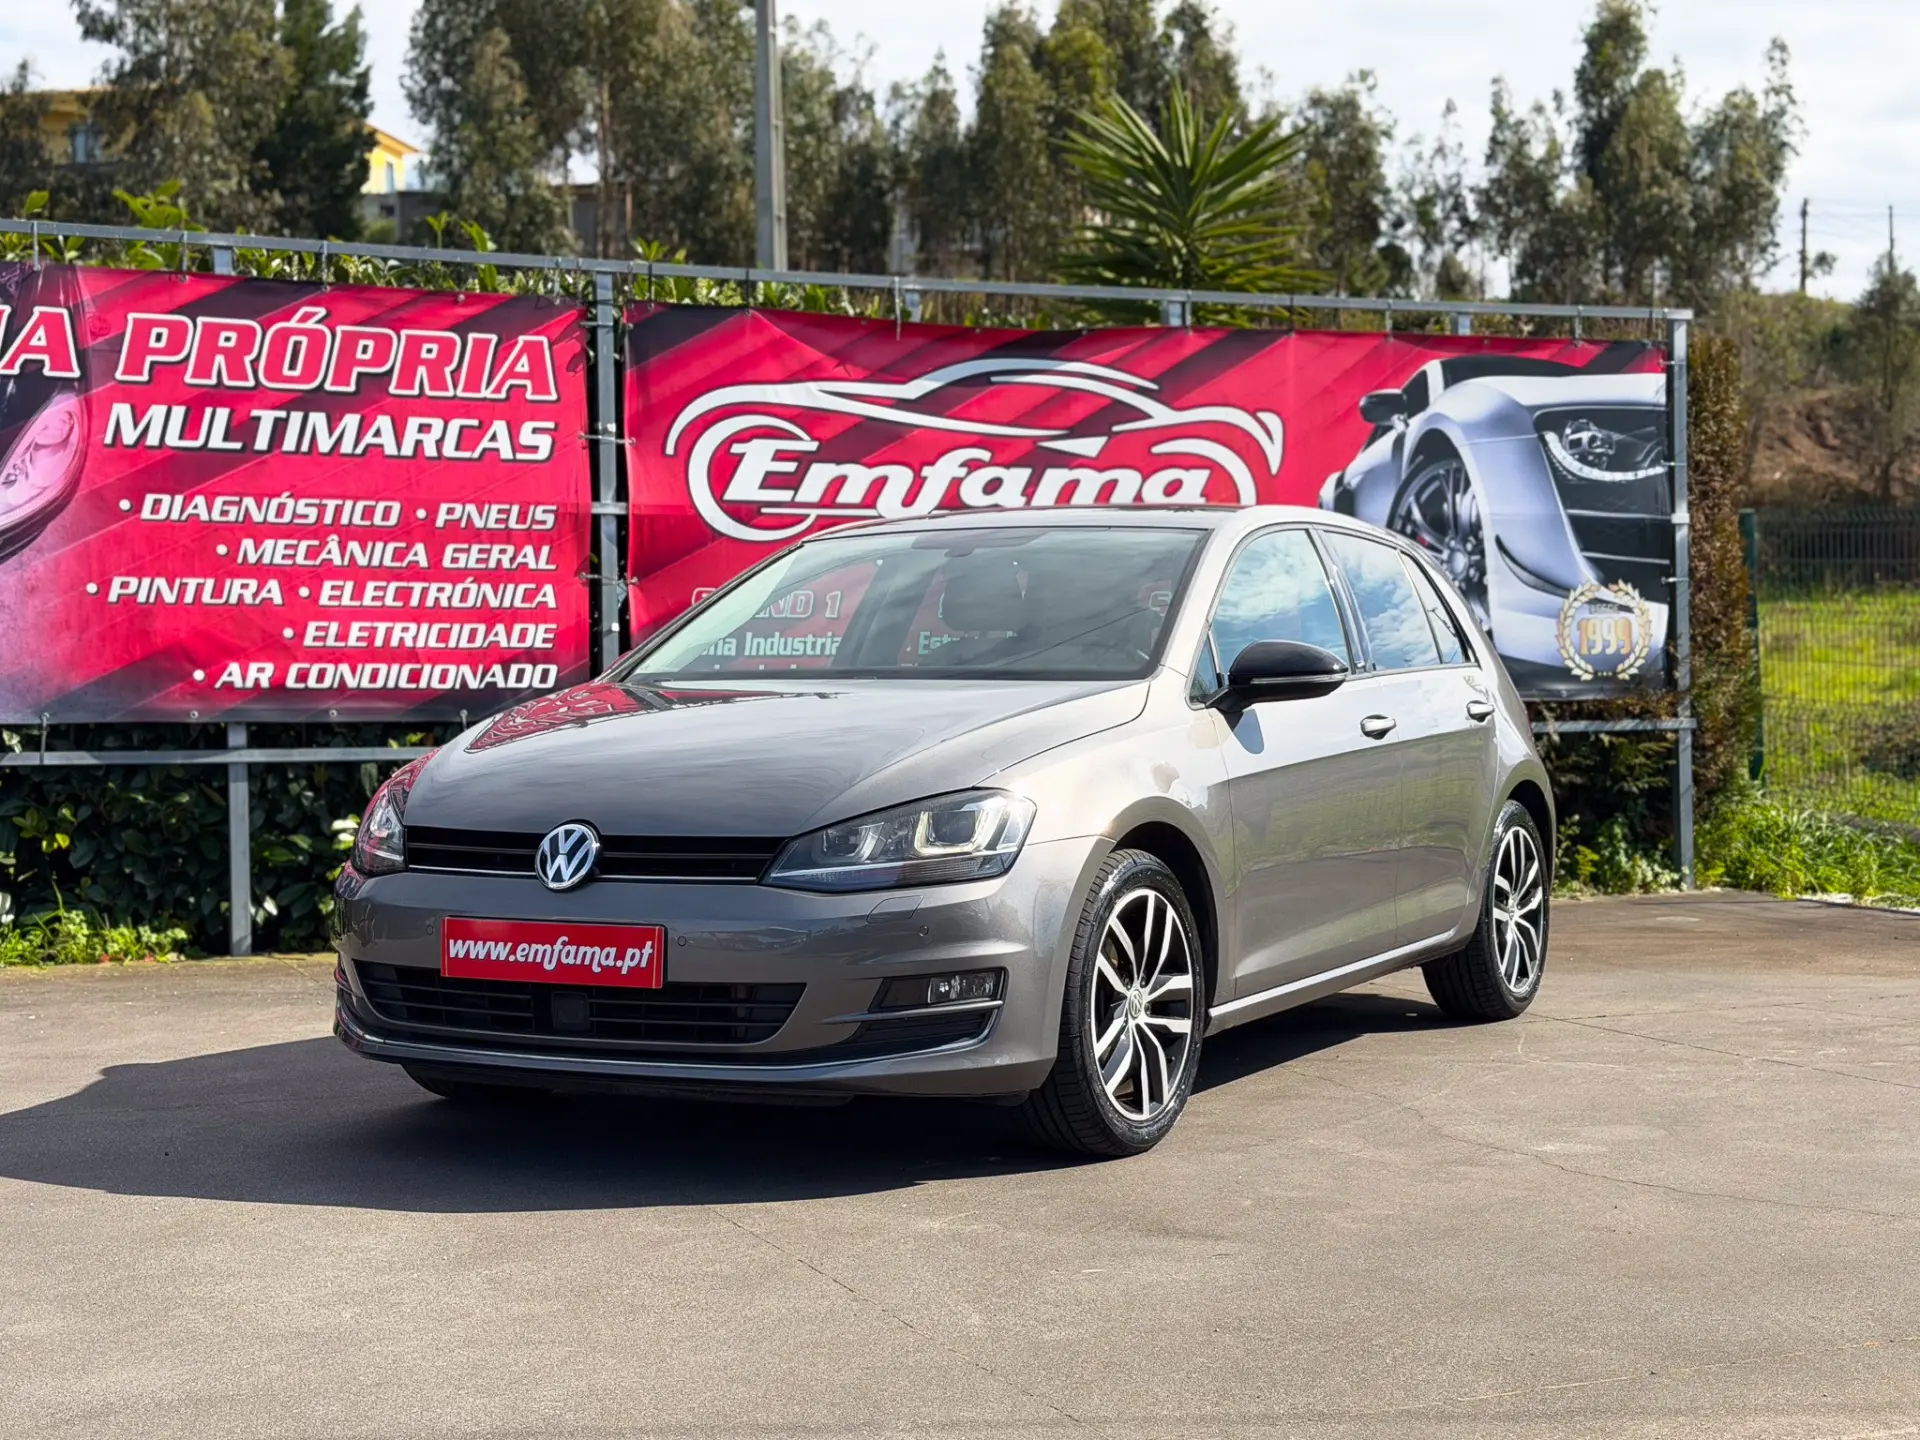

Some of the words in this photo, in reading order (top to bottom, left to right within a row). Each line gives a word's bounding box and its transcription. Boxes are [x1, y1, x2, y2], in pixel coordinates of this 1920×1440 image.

[0, 305, 81, 378] A
[115, 306, 557, 401] PRÓPRIA
[103, 403, 555, 461] MULTIMARCAS
[721, 438, 1210, 514] Emfama
[140, 491, 401, 527] DIAGNÓSTICO
[435, 502, 557, 530] PNEUS
[237, 534, 428, 568] MECÂNICA
[441, 542, 557, 570] GERAL
[107, 576, 283, 605] PINTURA
[318, 577, 557, 609] ELECTRÓNICA
[303, 621, 557, 649] ELETRICIDADE
[1577, 617, 1632, 655] 1999
[215, 662, 274, 689] AR
[285, 663, 558, 690] CONDICIONADO
[449, 935, 653, 975] www.emfama.pt
